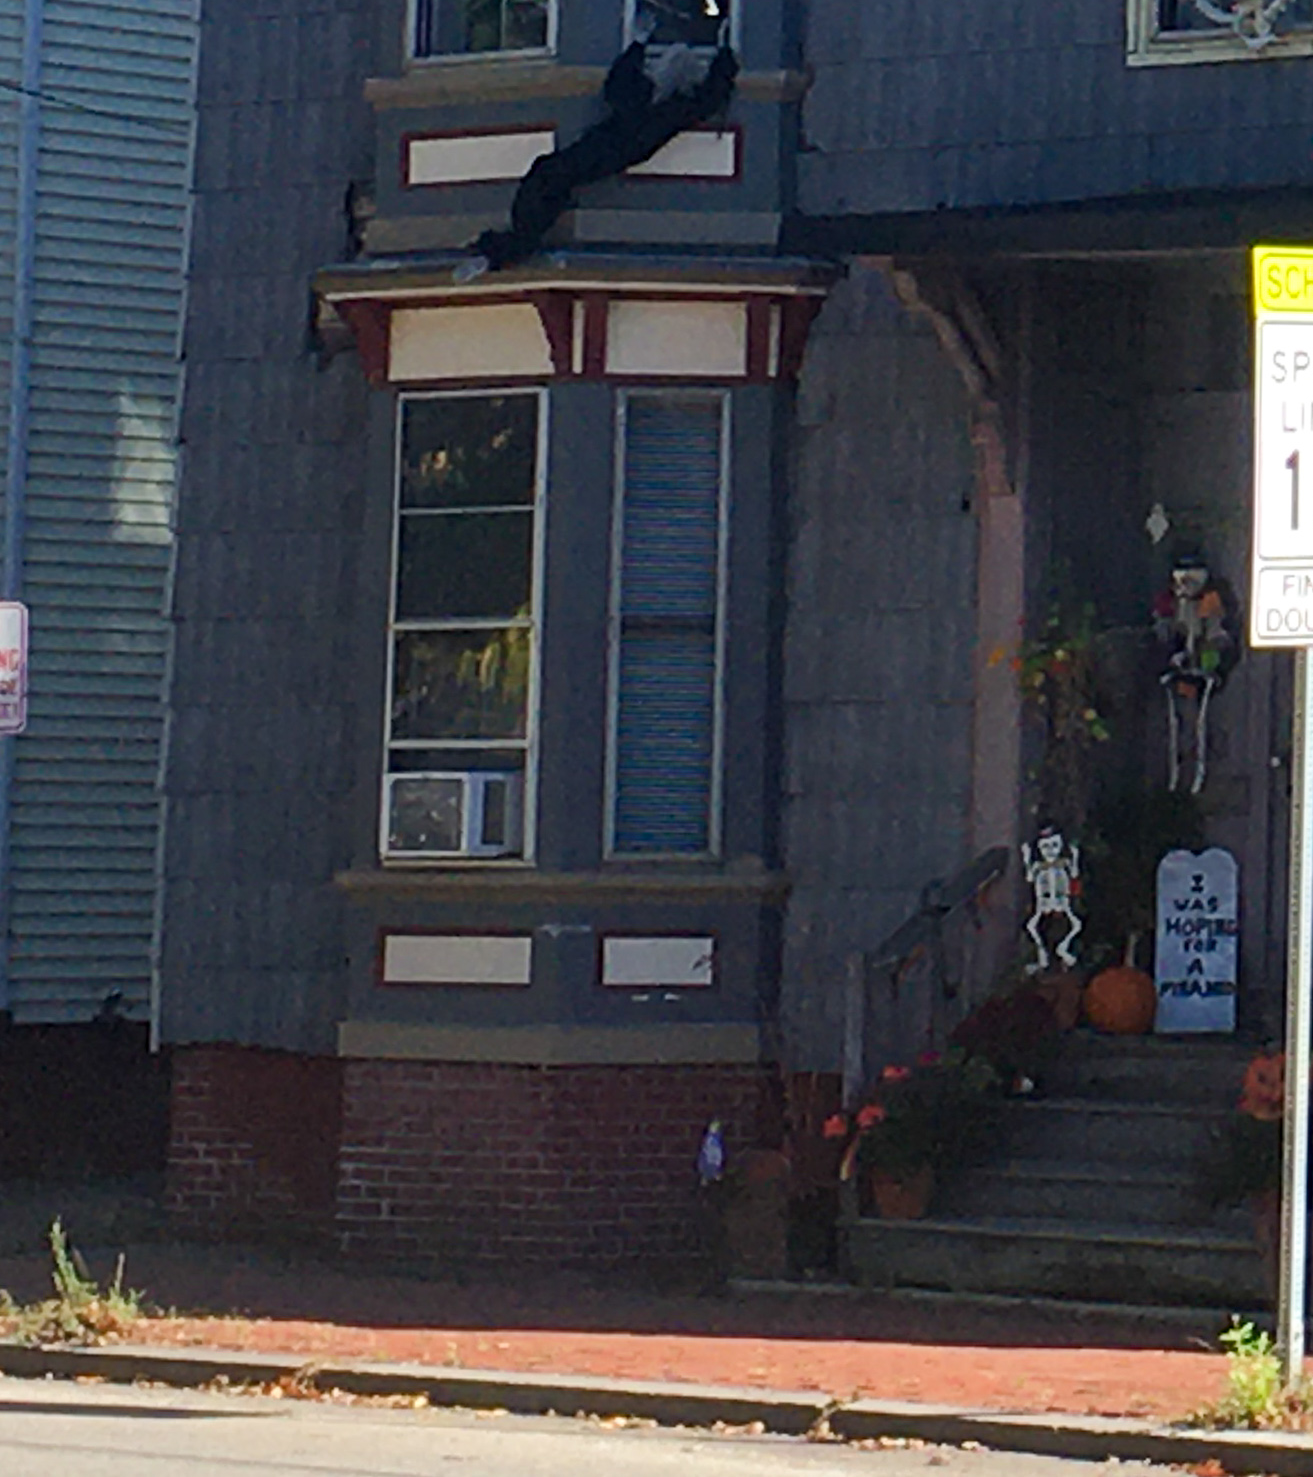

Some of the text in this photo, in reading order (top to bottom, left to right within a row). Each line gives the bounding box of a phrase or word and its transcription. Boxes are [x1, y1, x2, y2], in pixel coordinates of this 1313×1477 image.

[1190, 874, 1204, 893] I
[1173, 896, 1218, 912] WAS
[1187, 958, 1203, 975] A
